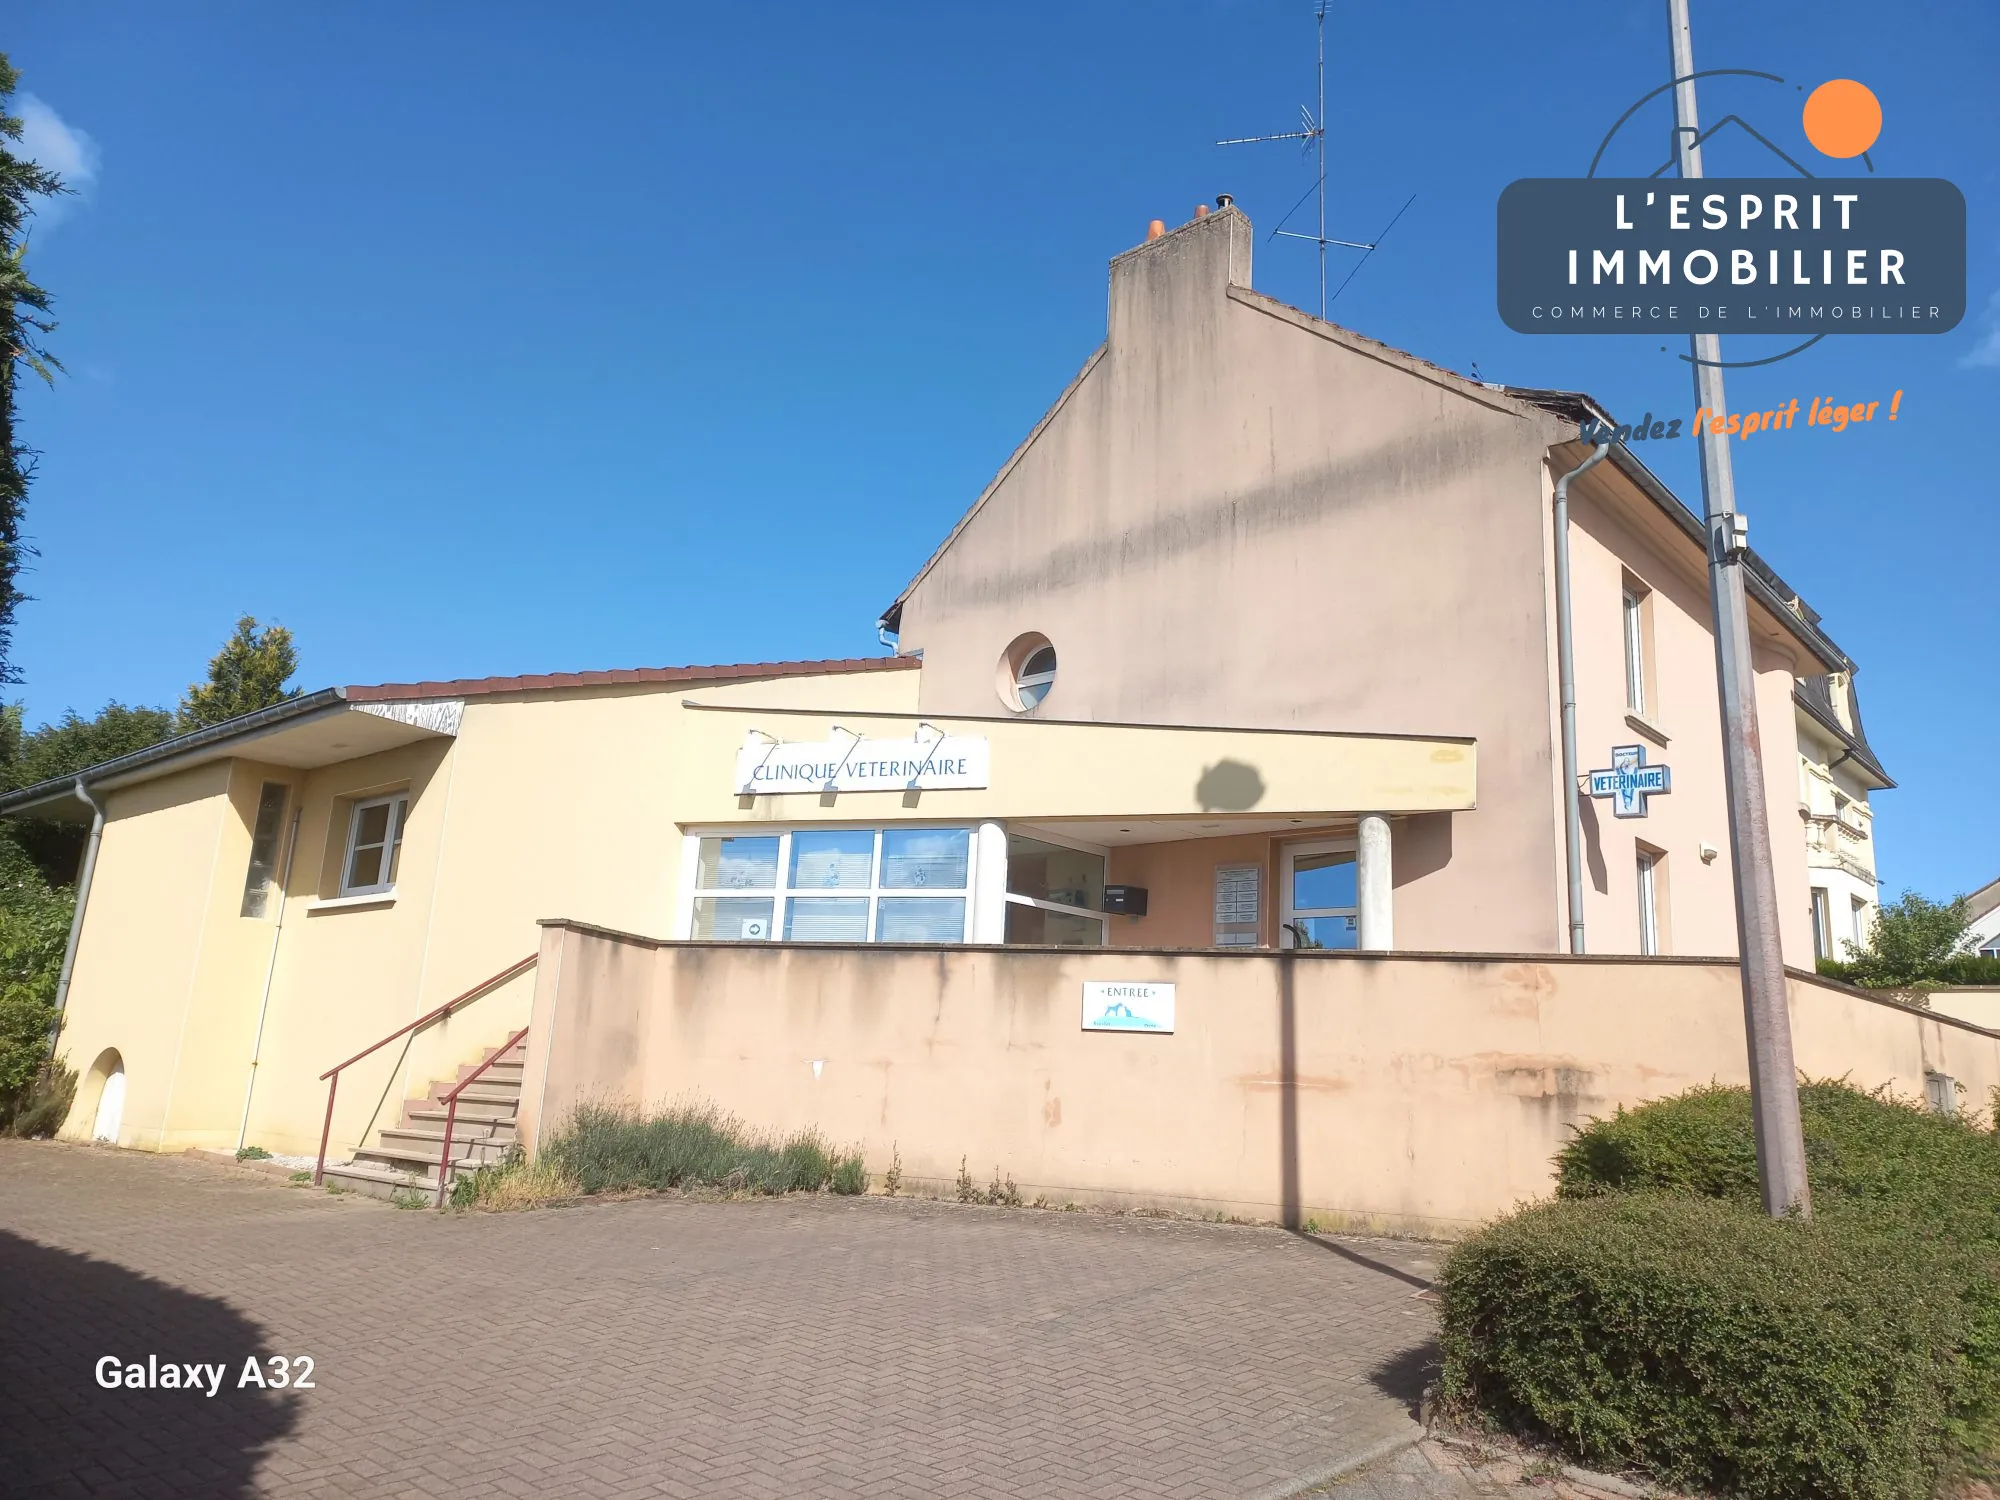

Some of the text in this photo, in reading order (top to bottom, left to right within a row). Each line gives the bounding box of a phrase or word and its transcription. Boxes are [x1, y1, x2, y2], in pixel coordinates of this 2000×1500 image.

[753, 758, 967, 783] CLINIQUE VETERINAIRE
[1594, 772, 1662, 791] VETERINAIRE
[1107, 987, 1149, 998] ENTREE
